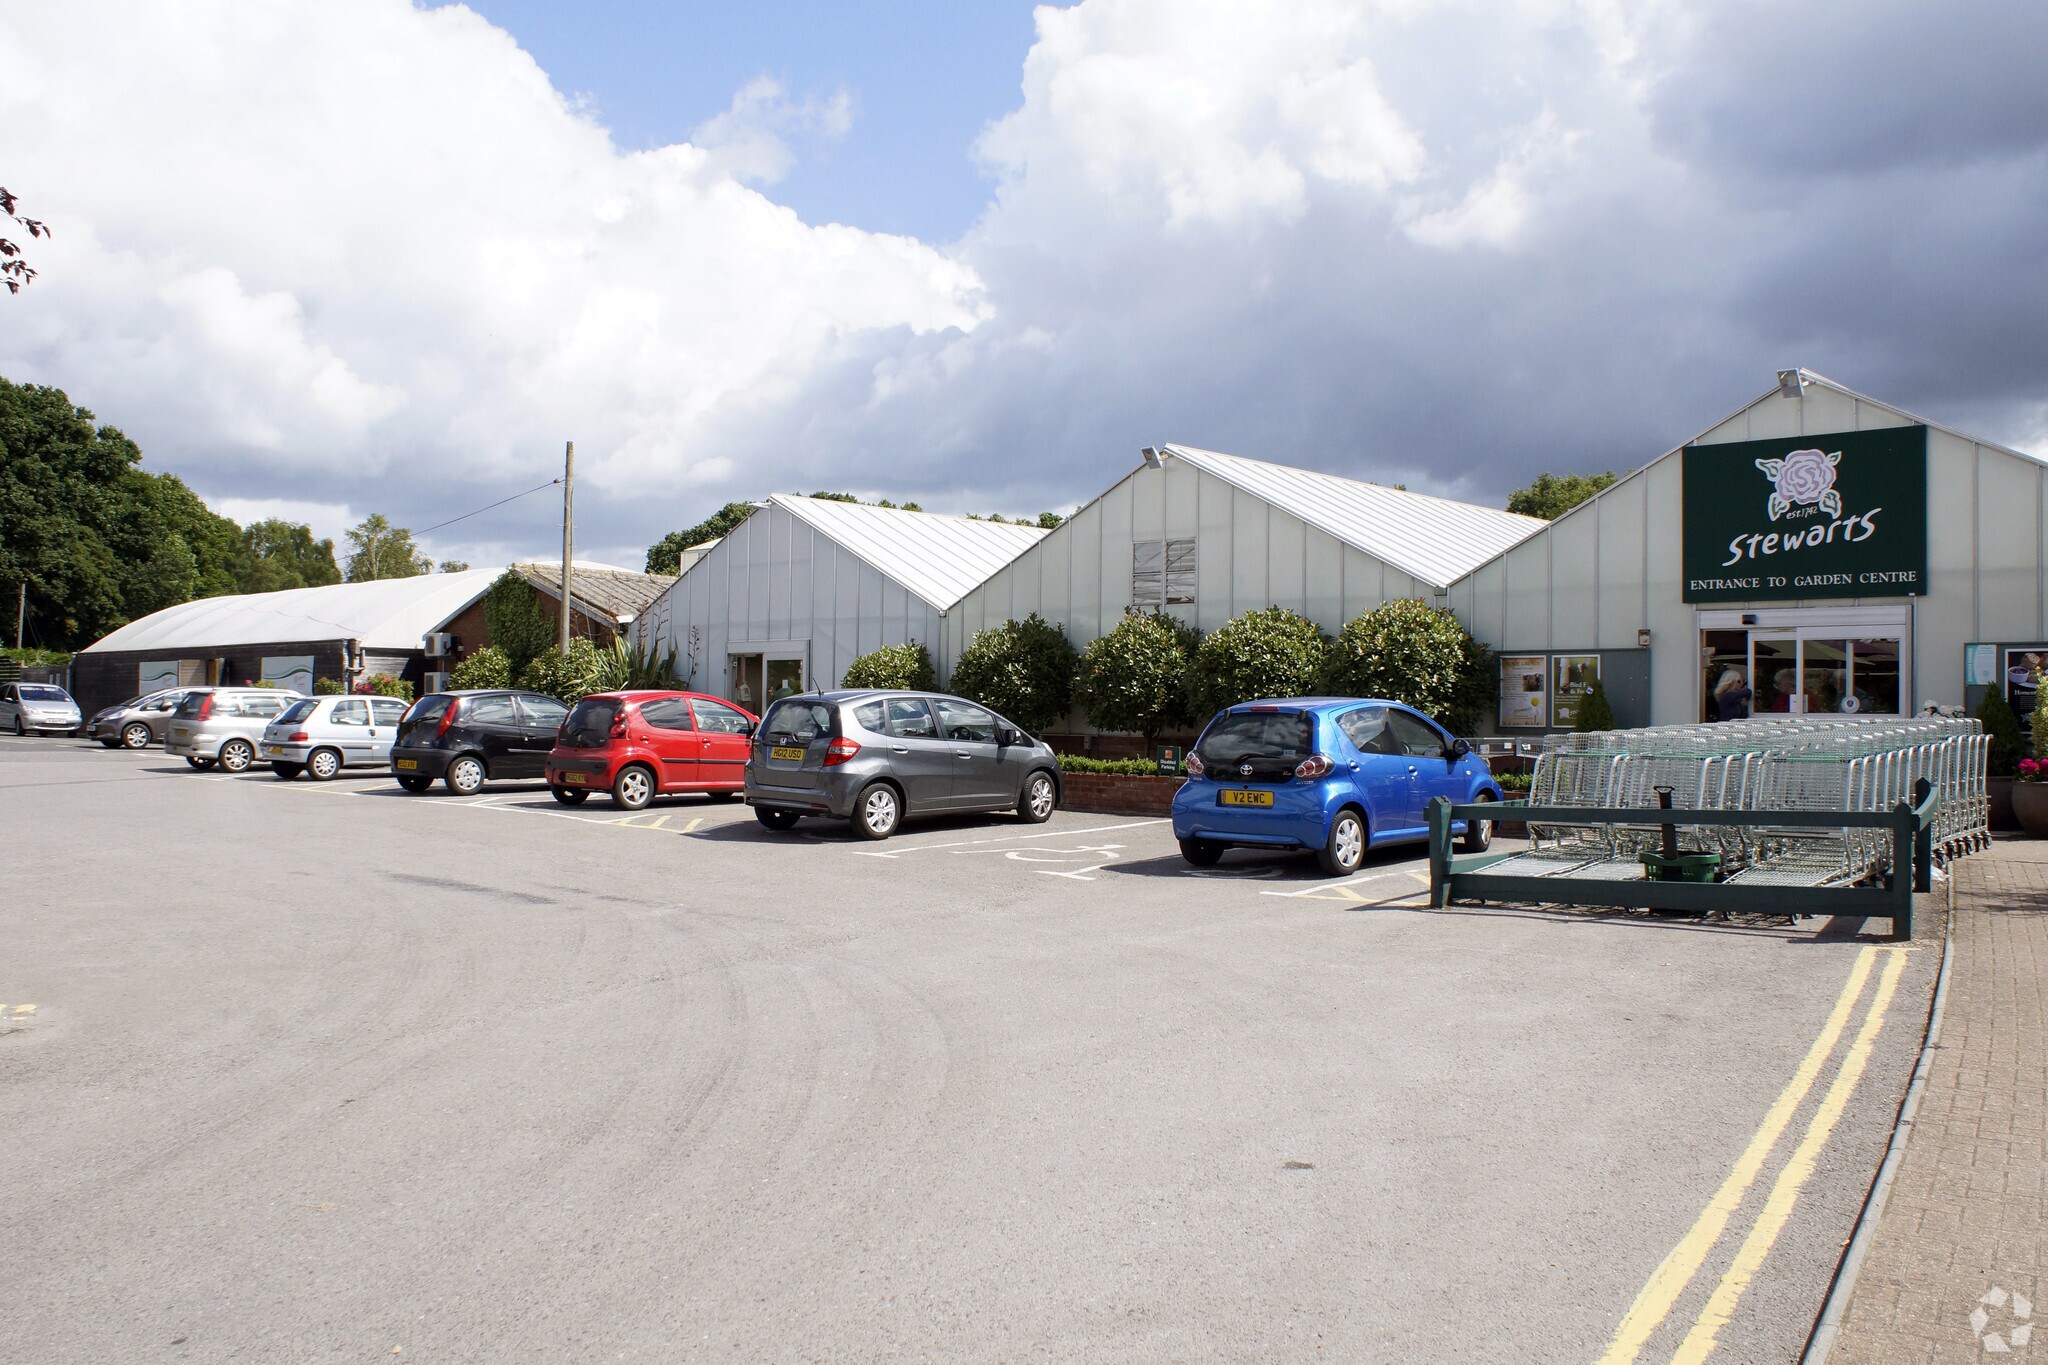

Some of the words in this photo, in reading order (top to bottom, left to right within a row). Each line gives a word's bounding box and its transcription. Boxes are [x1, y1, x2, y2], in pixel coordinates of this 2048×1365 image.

[1690, 577, 1760, 590] ENTRANCE
[1767, 576, 1787, 587] TO
[1794, 573, 1852, 587] GARDEN
[1859, 570, 1917, 583] CENTRE
[774, 748, 788, 758] HG12
[1233, 791, 1245, 803] V2
[1247, 792, 1265, 803] EWC
